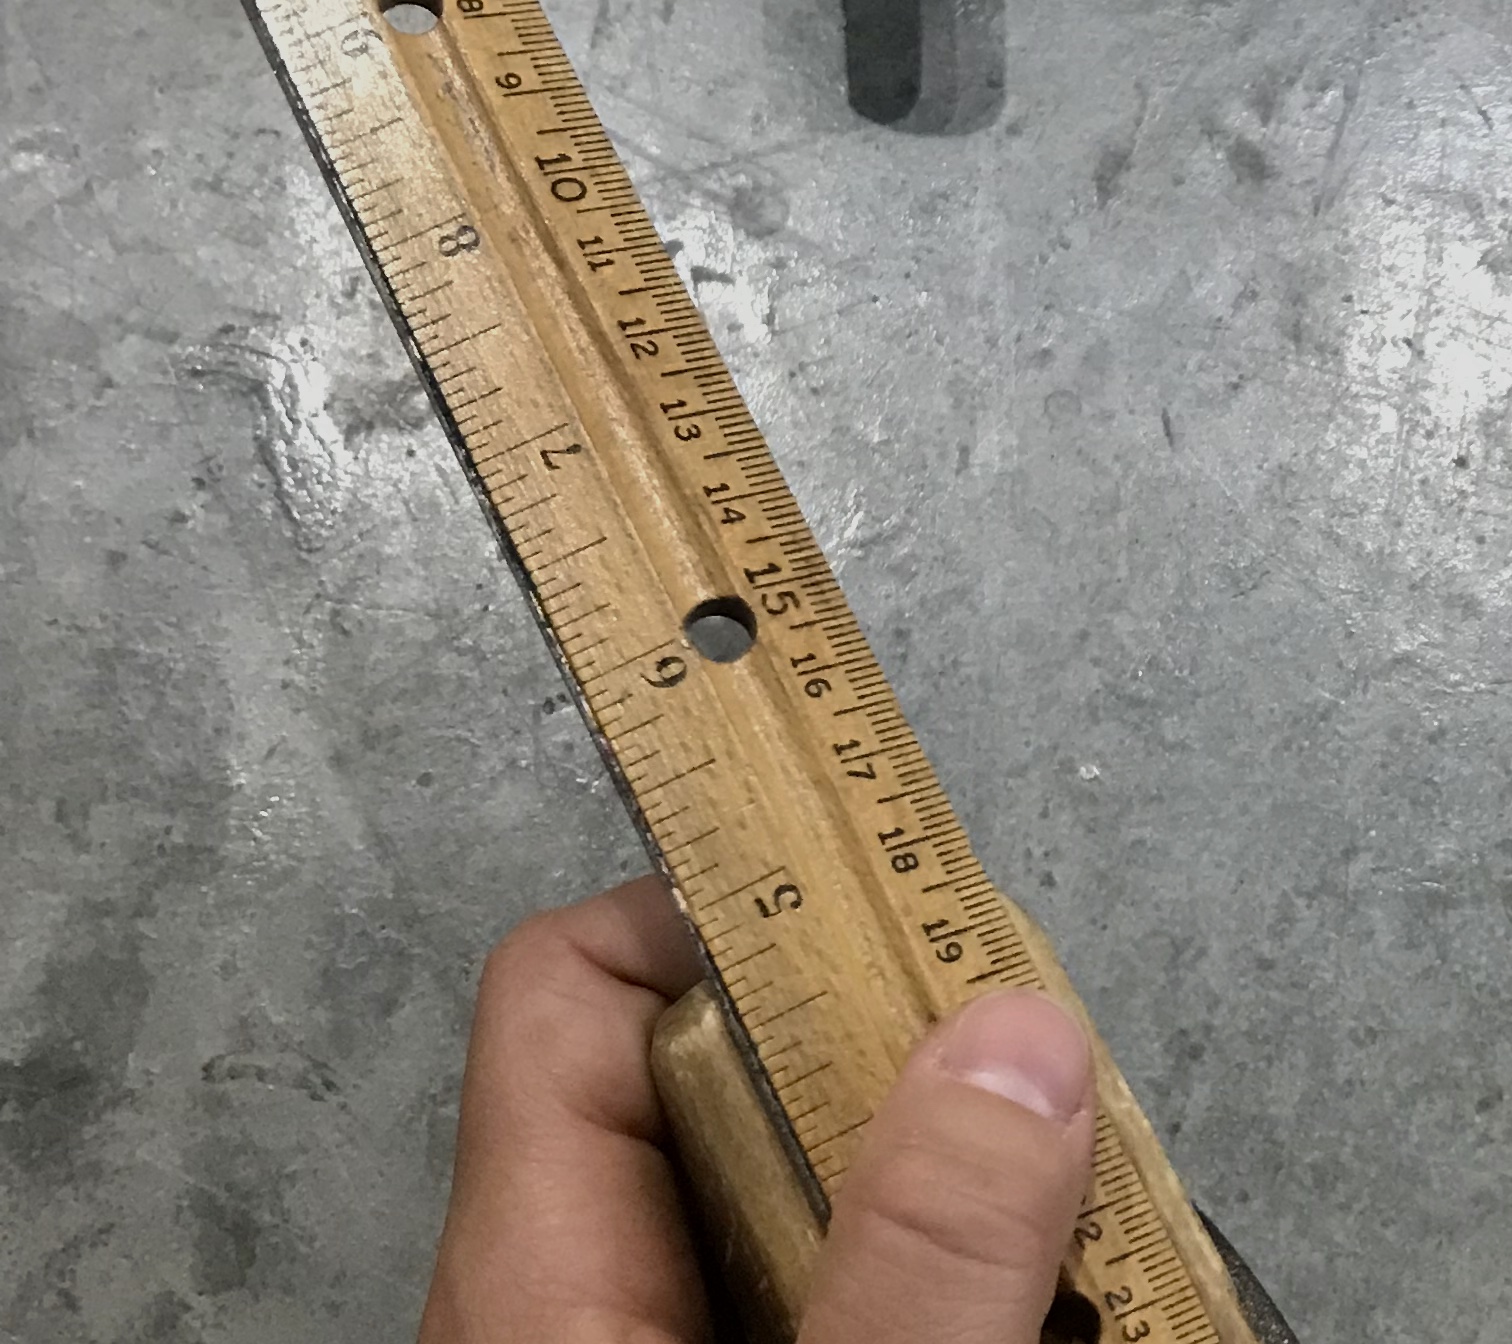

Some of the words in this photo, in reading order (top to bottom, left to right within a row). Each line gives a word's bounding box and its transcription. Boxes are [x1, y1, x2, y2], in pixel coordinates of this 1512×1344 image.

[340, 28, 383, 58] 9
[438, 225, 481, 258] 8
[540, 443, 582, 471] 7
[640, 656, 688, 689] 6
[754, 882, 804, 919] 5
[495, 72, 522, 90] 9
[535, 152, 588, 202] 10
[577, 235, 615, 273] 11
[617, 316, 659, 359] 12
[660, 398, 701, 442] 13
[703, 482, 747, 525] 14
[743, 562, 801, 616] 15
[789, 652, 833, 699] 16
[832, 738, 878, 783] 17
[877, 826, 920, 875] 18
[921, 917, 964, 964] 19
[1104, 1285, 1151, 1344] 23
